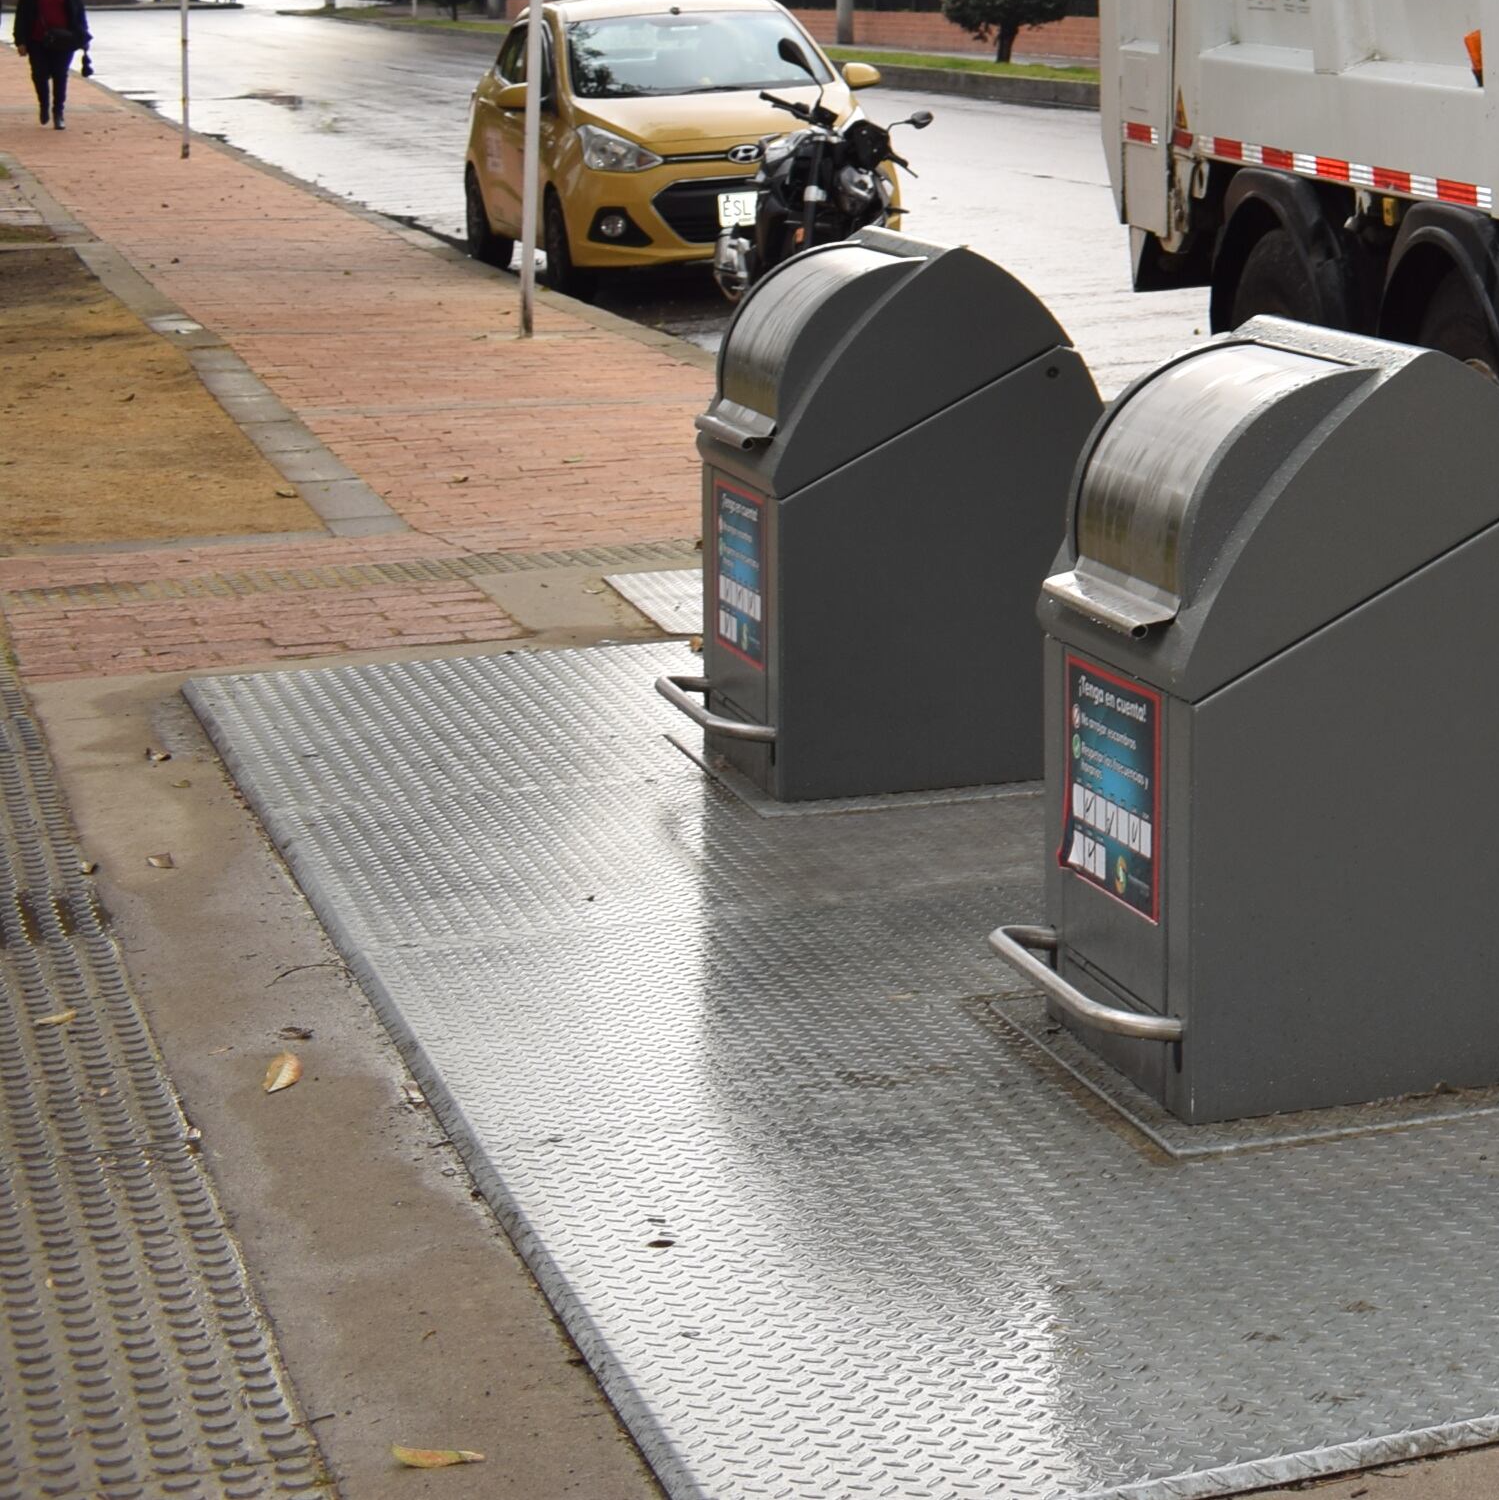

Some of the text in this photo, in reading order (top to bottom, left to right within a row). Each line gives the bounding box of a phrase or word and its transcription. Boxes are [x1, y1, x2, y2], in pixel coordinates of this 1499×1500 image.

[723, 200, 752, 217] ESL
[1078, 675, 1147, 723] ¡Tenga en cuenta!
